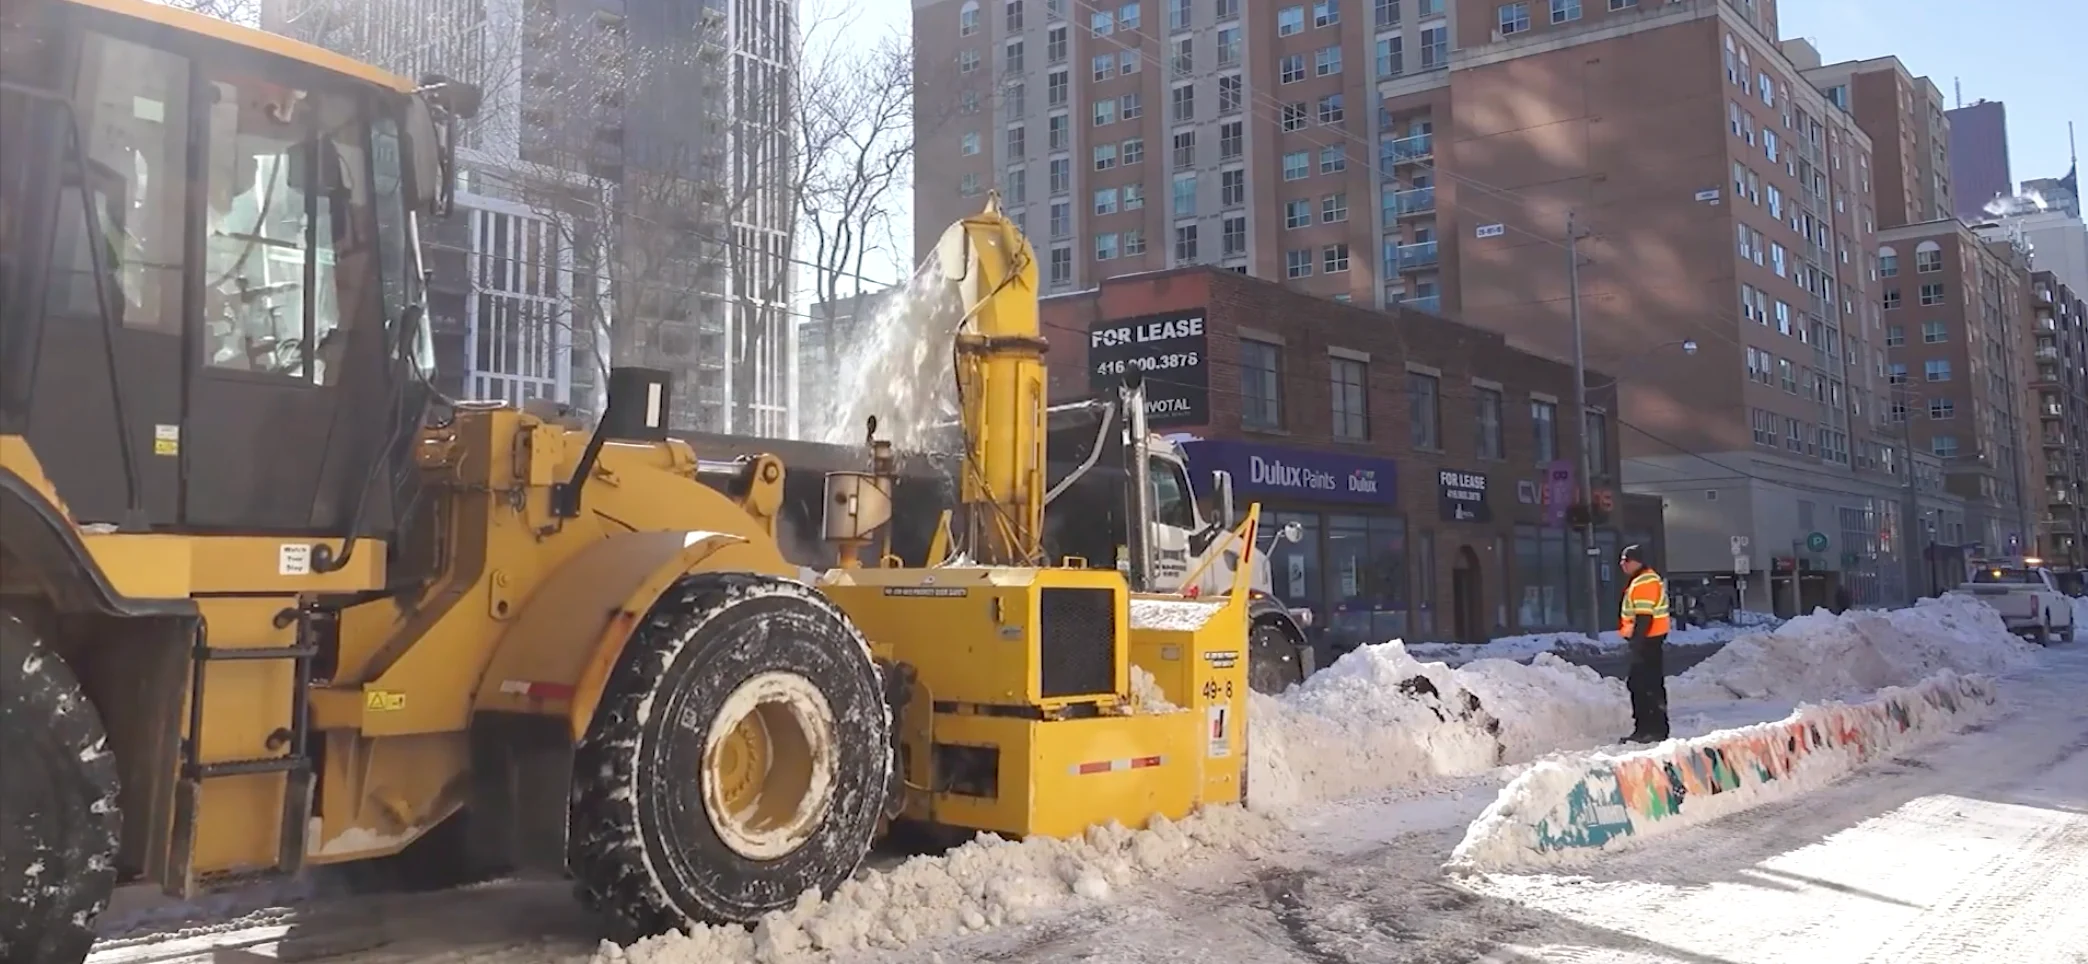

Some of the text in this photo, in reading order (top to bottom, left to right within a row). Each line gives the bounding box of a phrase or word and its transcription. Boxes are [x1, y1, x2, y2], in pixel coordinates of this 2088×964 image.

[1091, 318, 1203, 348] FOR LEASE
[1144, 399, 1191, 413] IVOTAL
[1250, 455, 1336, 490] Dulux Paints
[1440, 471, 1485, 490] FOR LEASE
[1348, 475, 1377, 492] Dulux
